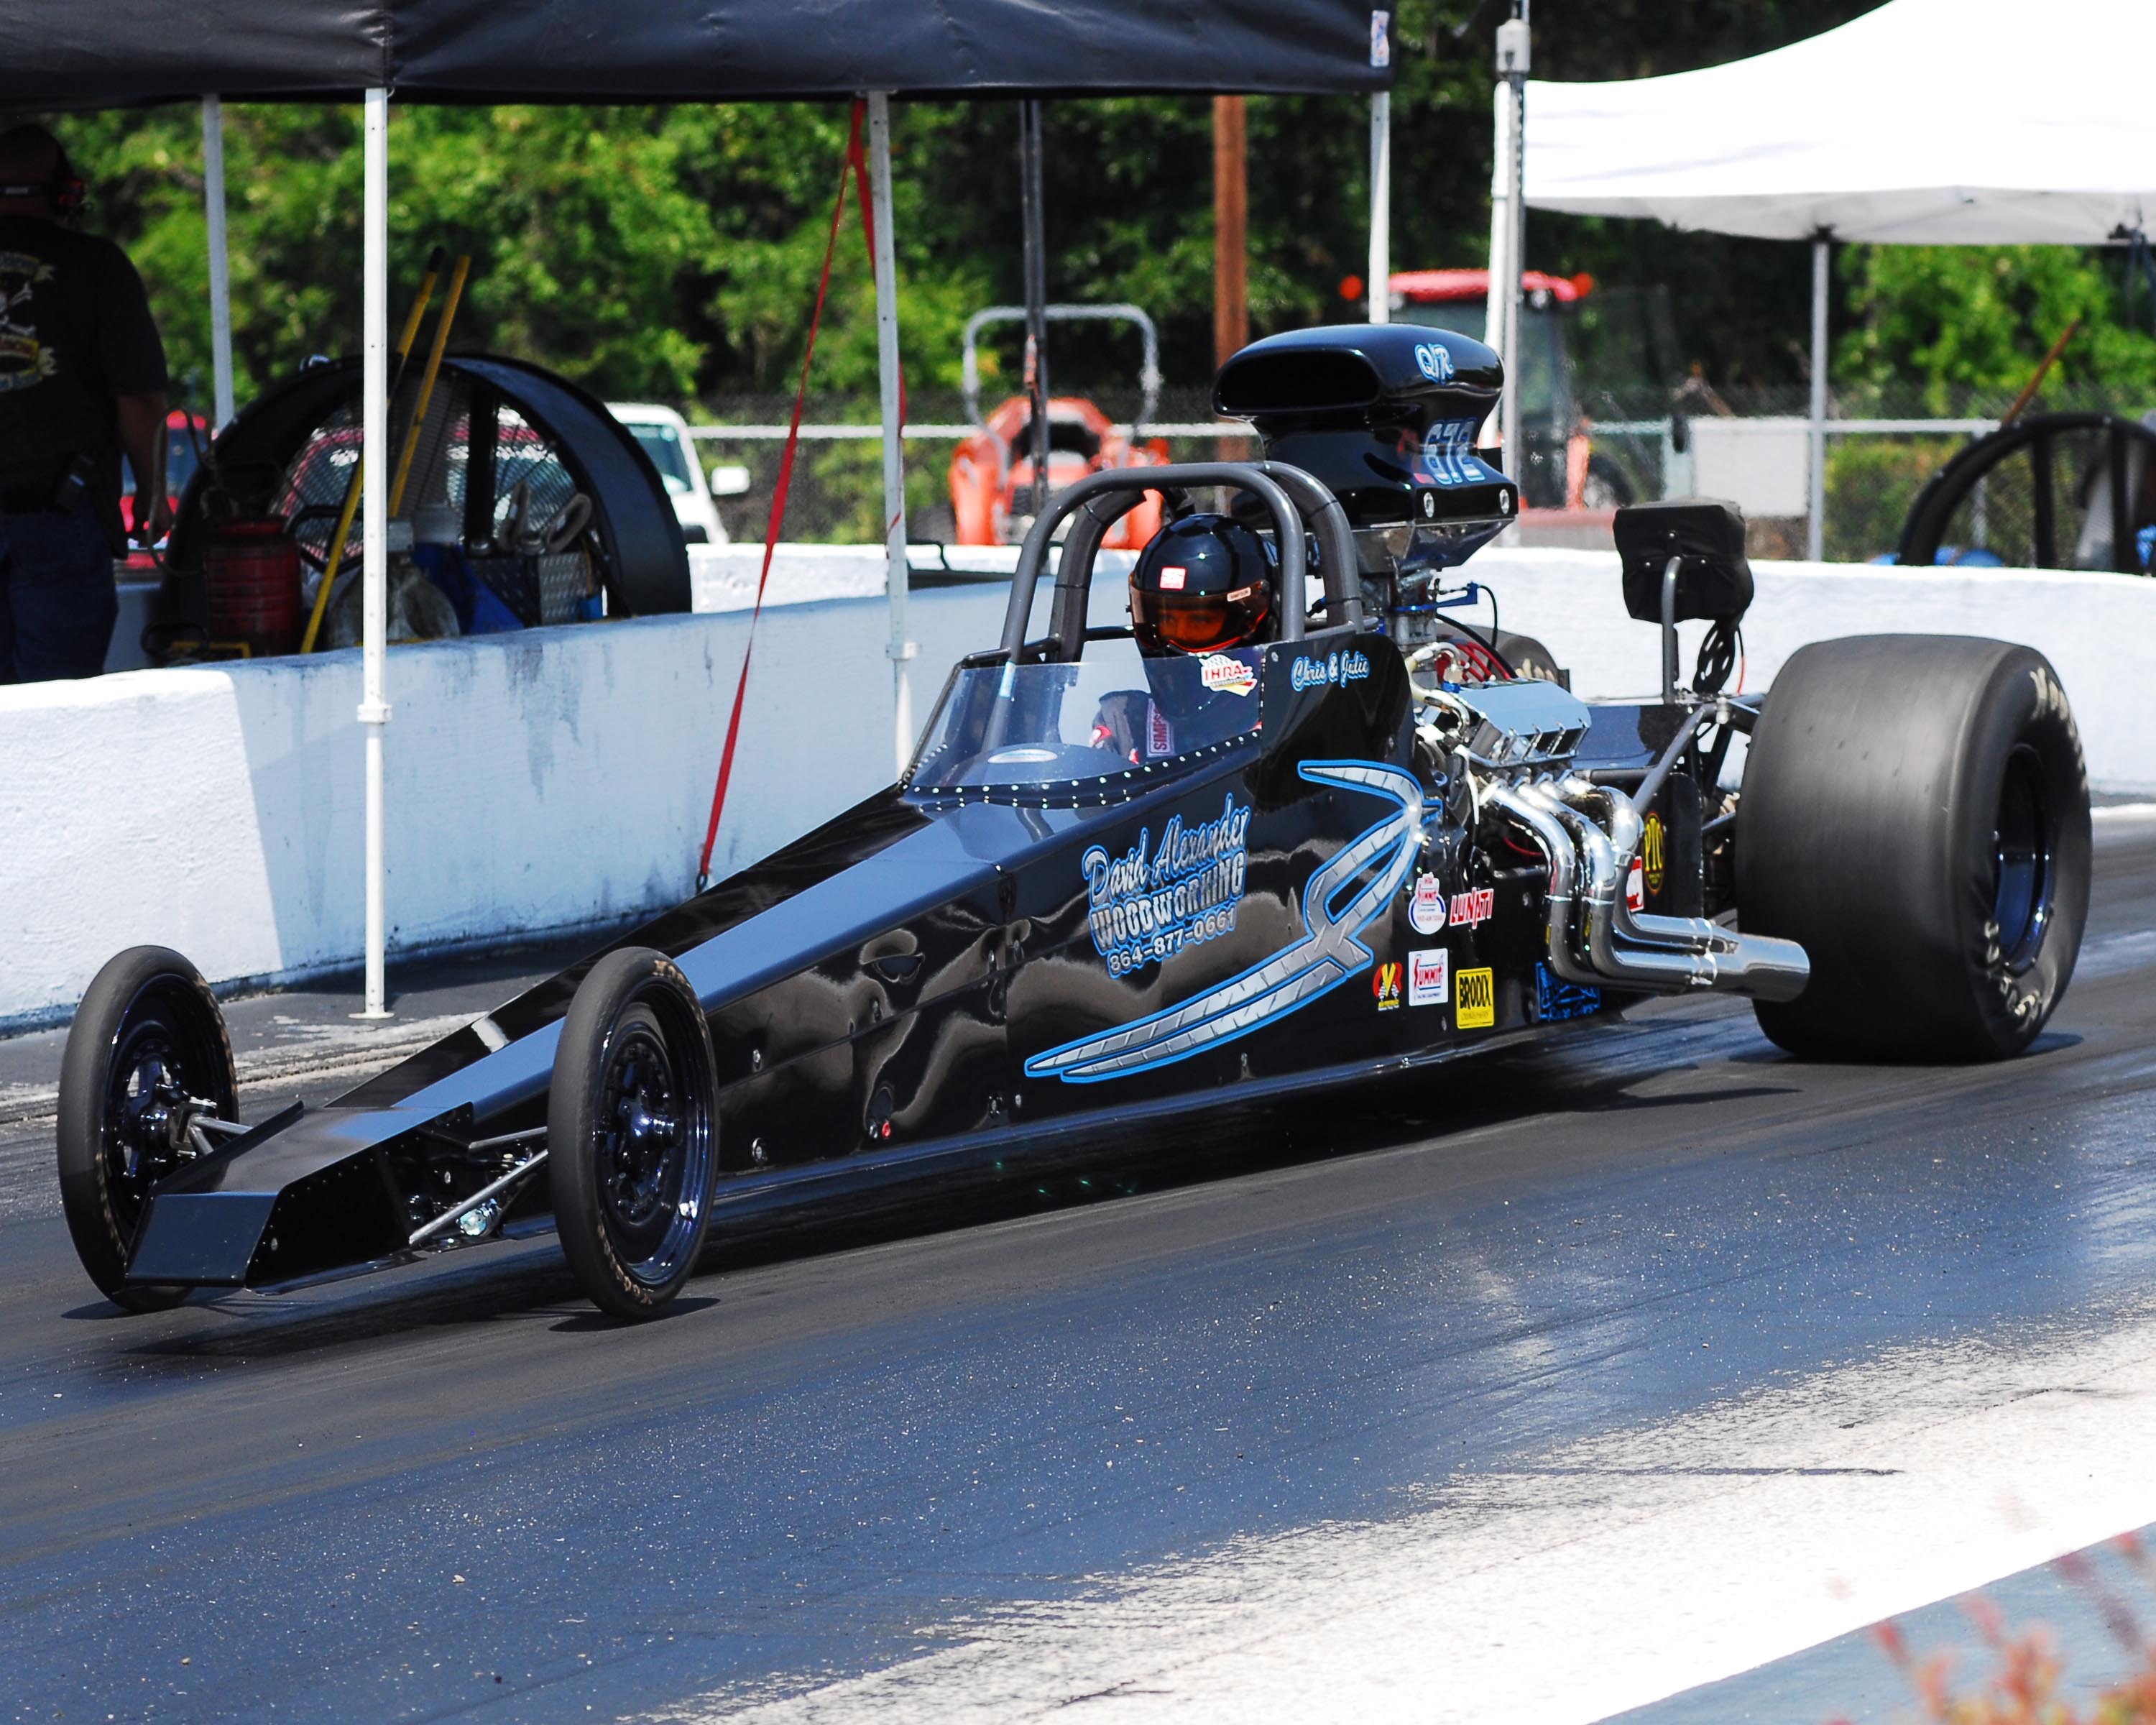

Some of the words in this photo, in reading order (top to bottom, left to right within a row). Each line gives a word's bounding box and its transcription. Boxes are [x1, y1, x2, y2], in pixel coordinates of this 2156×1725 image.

[1204, 664, 1243, 681] IHRA
[1291, 656, 1327, 691] Chris
[1327, 652, 1339, 684] &
[1340, 649, 1370, 688] Julie
[1152, 704, 1168, 751] SIMPS
[1083, 828, 1149, 906] David
[1151, 793, 1250, 888] Alexander
[1089, 850, 1247, 954] WOODWORKING
[1450, 887, 1494, 930] LUNATI
[1108, 904, 1236, 977] 864-877-0661
[1460, 974, 1492, 1010] BRODIX
